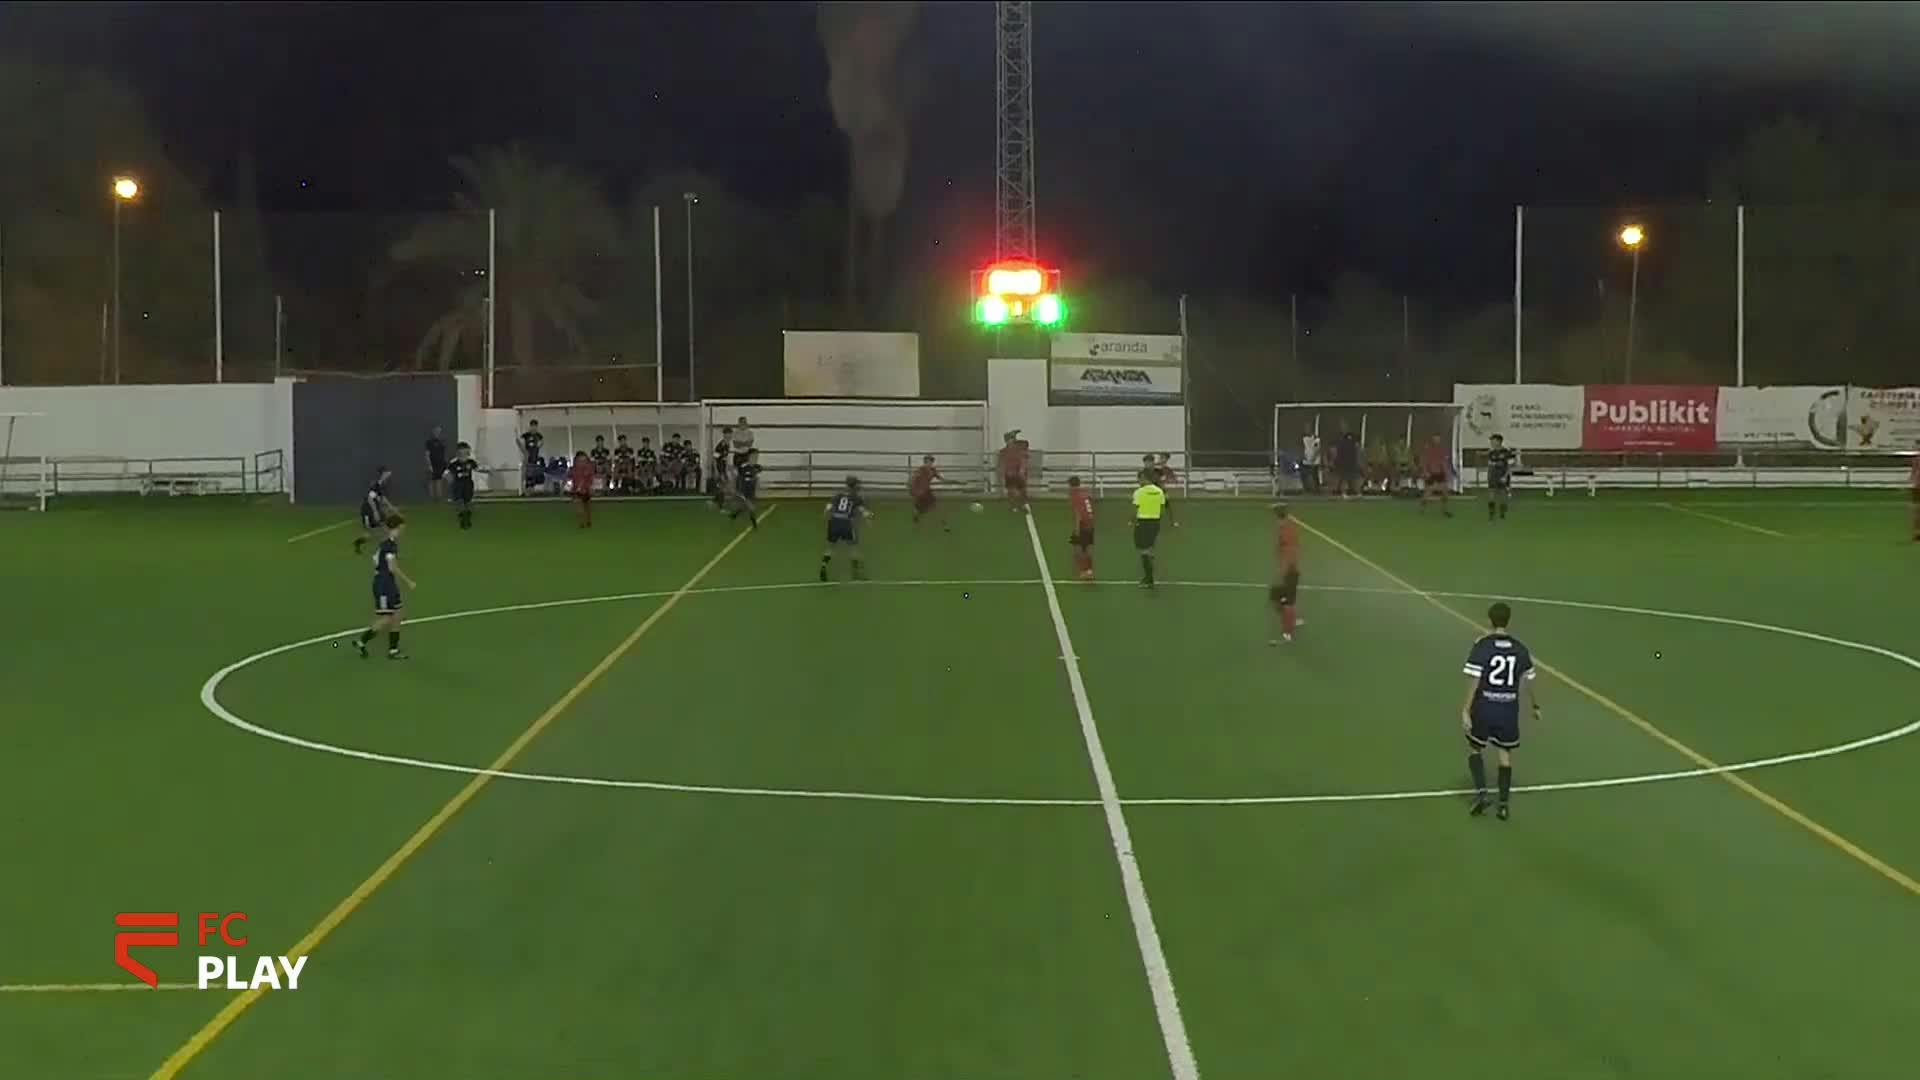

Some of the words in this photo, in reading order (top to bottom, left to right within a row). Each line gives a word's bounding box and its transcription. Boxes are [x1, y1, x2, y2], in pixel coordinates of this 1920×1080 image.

[1101, 342, 1148, 353] aranda
[1590, 400, 1709, 424] Publikit
[1489, 655, 1516, 686] 21
